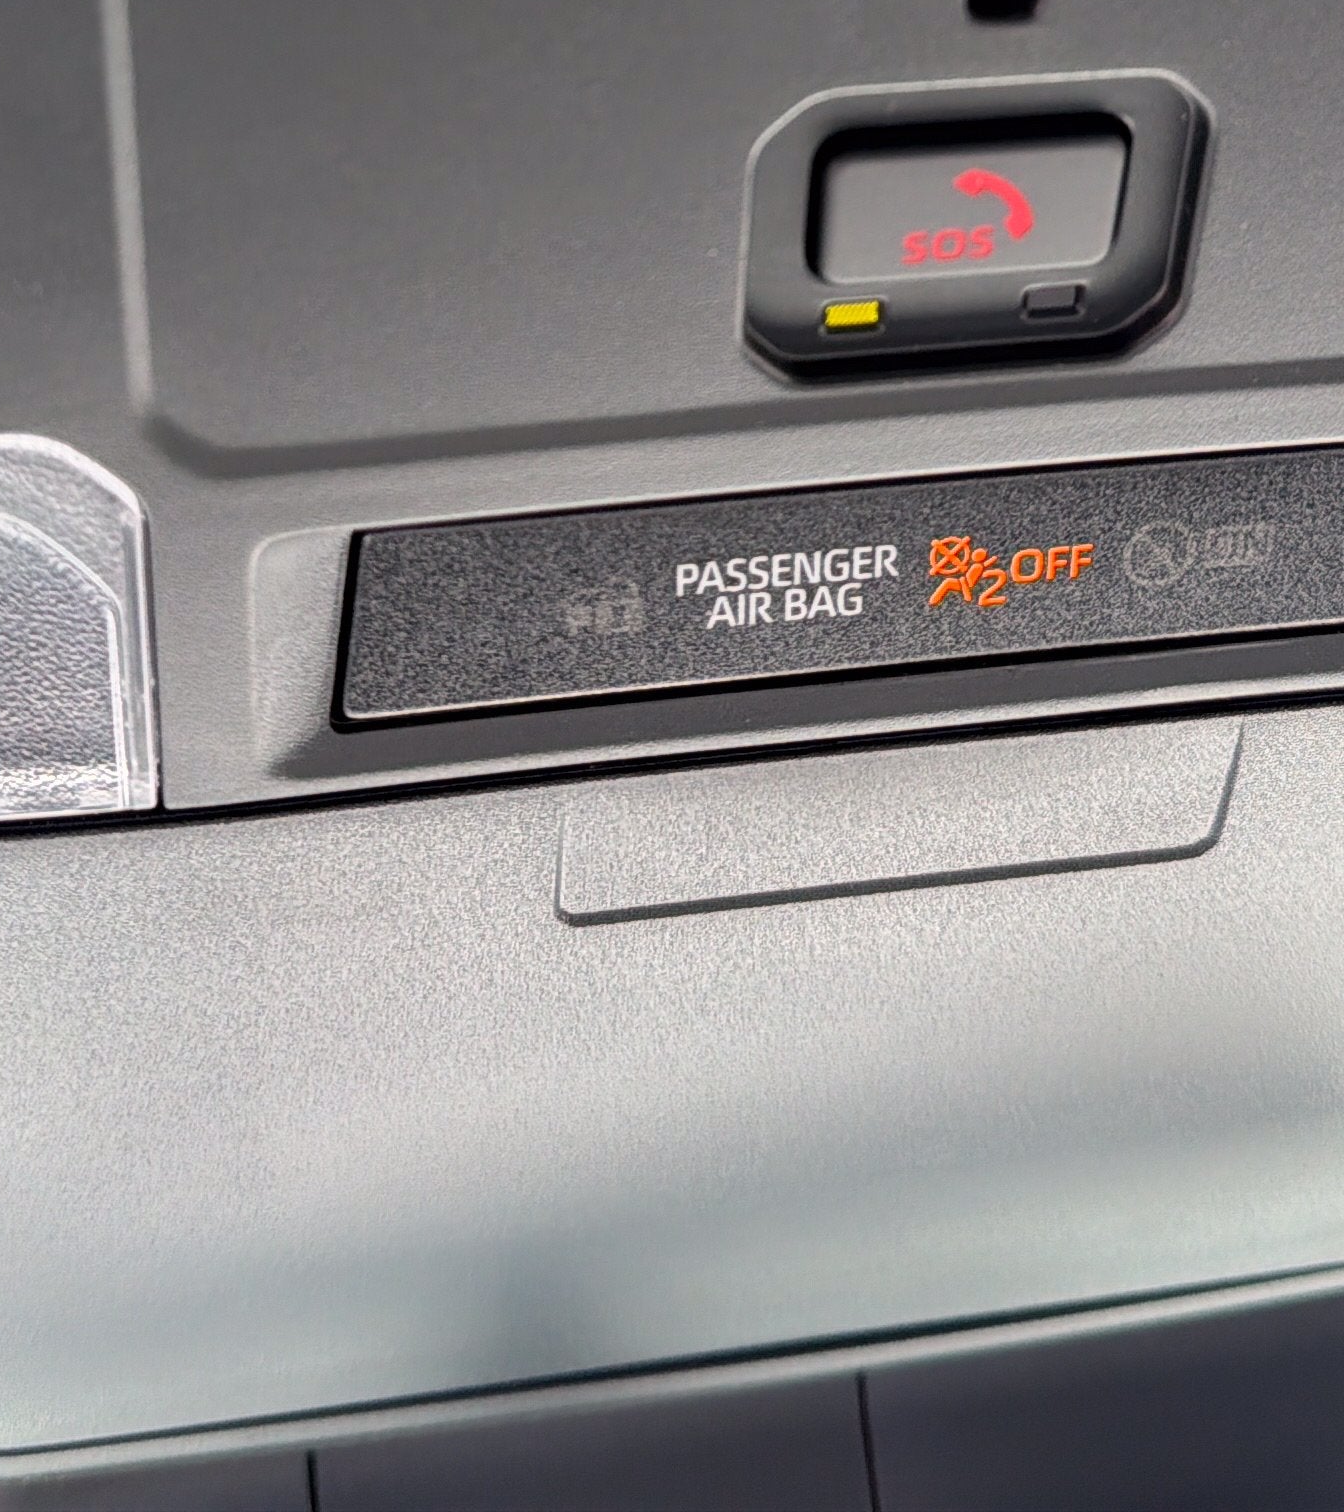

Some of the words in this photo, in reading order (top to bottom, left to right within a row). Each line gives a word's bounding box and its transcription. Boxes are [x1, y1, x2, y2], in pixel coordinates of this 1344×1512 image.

[900, 225, 995, 266] SOS
[675, 543, 899, 598] PASSENGER
[1009, 542, 1096, 585] OFF
[706, 592, 774, 630] AIR
[783, 582, 865, 621] BAG
